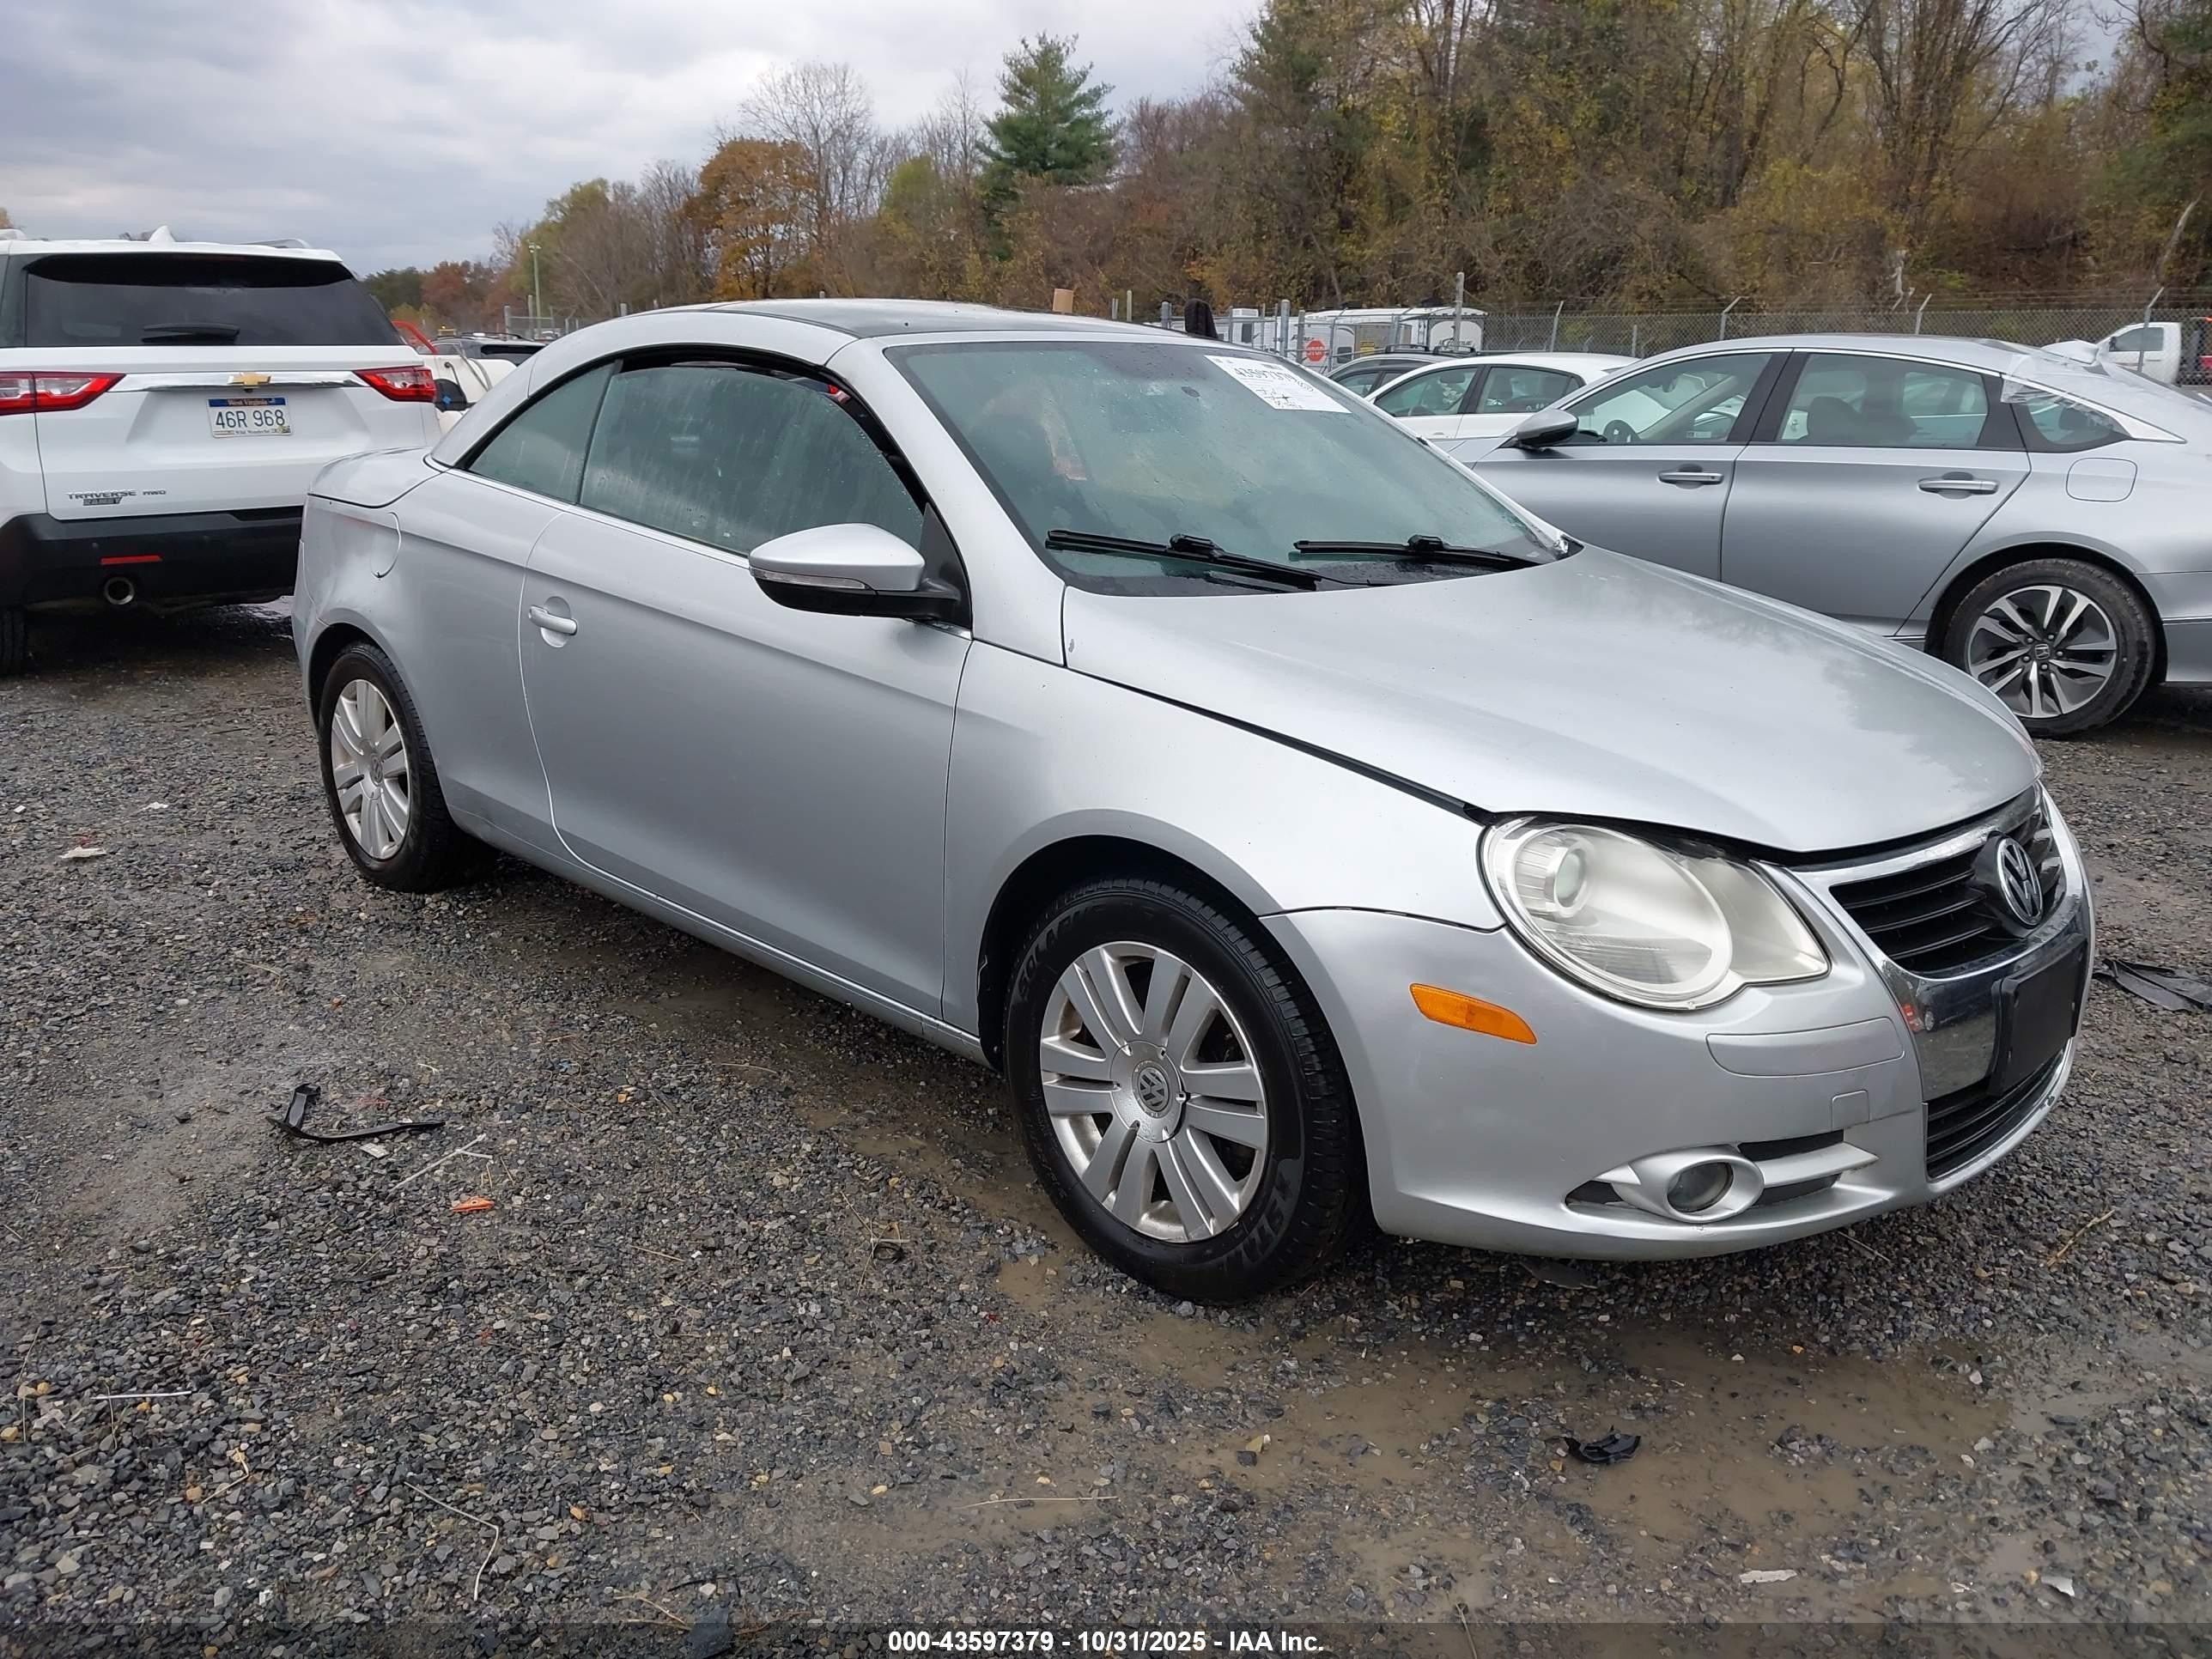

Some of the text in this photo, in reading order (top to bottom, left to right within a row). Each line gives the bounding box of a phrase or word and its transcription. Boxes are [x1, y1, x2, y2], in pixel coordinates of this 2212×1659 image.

[216, 409, 285, 428] 46R 968
[68, 489, 137, 500] TRAVERSE
